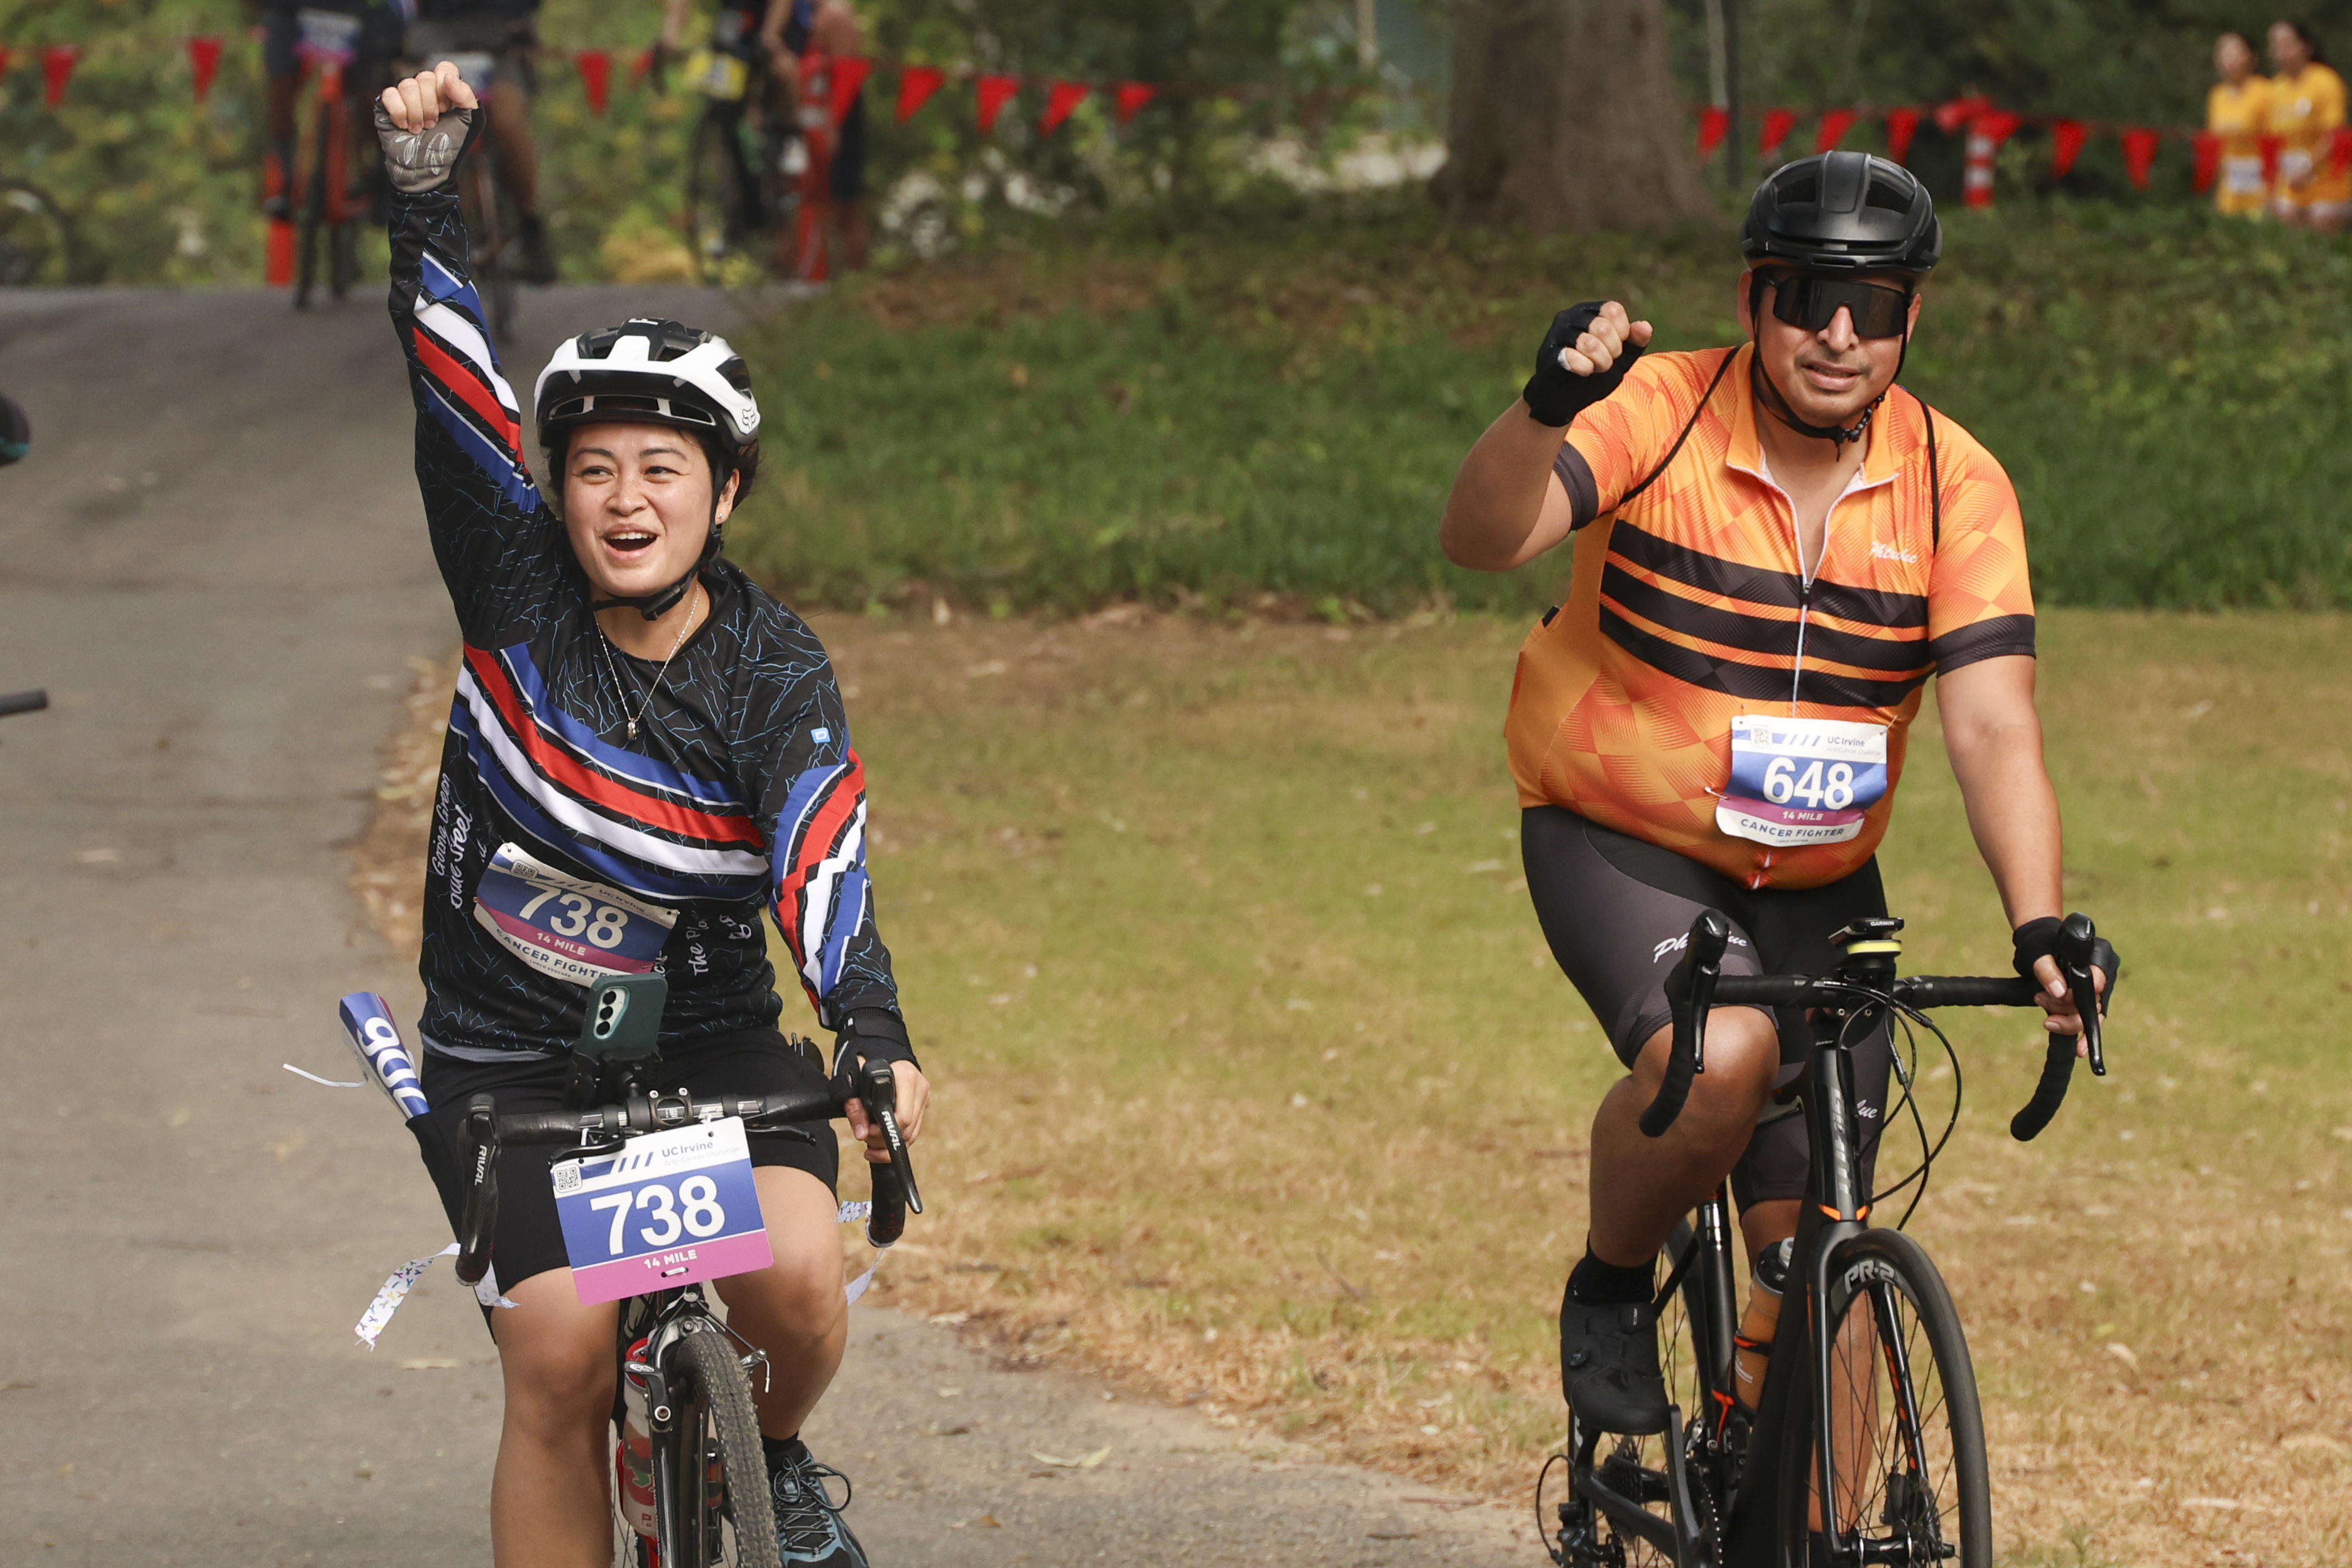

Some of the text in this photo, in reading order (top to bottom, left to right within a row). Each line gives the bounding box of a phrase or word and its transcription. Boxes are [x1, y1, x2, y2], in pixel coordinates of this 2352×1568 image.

[1827, 736, 1865, 747] UC Irvine
[436, 773, 450, 824] Green
[1763, 756, 1854, 810] 648
[1740, 819, 1844, 837] CANCER FIGHTER
[1782, 810, 1824, 821] 14 MILE
[518, 881, 628, 949] 738
[496, 928, 550, 963] CANCER
[536, 932, 586, 956] 14 MILE
[688, 942, 709, 976] The
[881, 1111, 901, 1151] RIVAL
[474, 1145, 487, 1186] RIVAL
[662, 1141, 713, 1157] UC Irvine
[664, 1146, 740, 1167] Anti-Cancer Challenge
[590, 1175, 726, 1256] 738
[643, 1250, 697, 1269] 14 MILE
